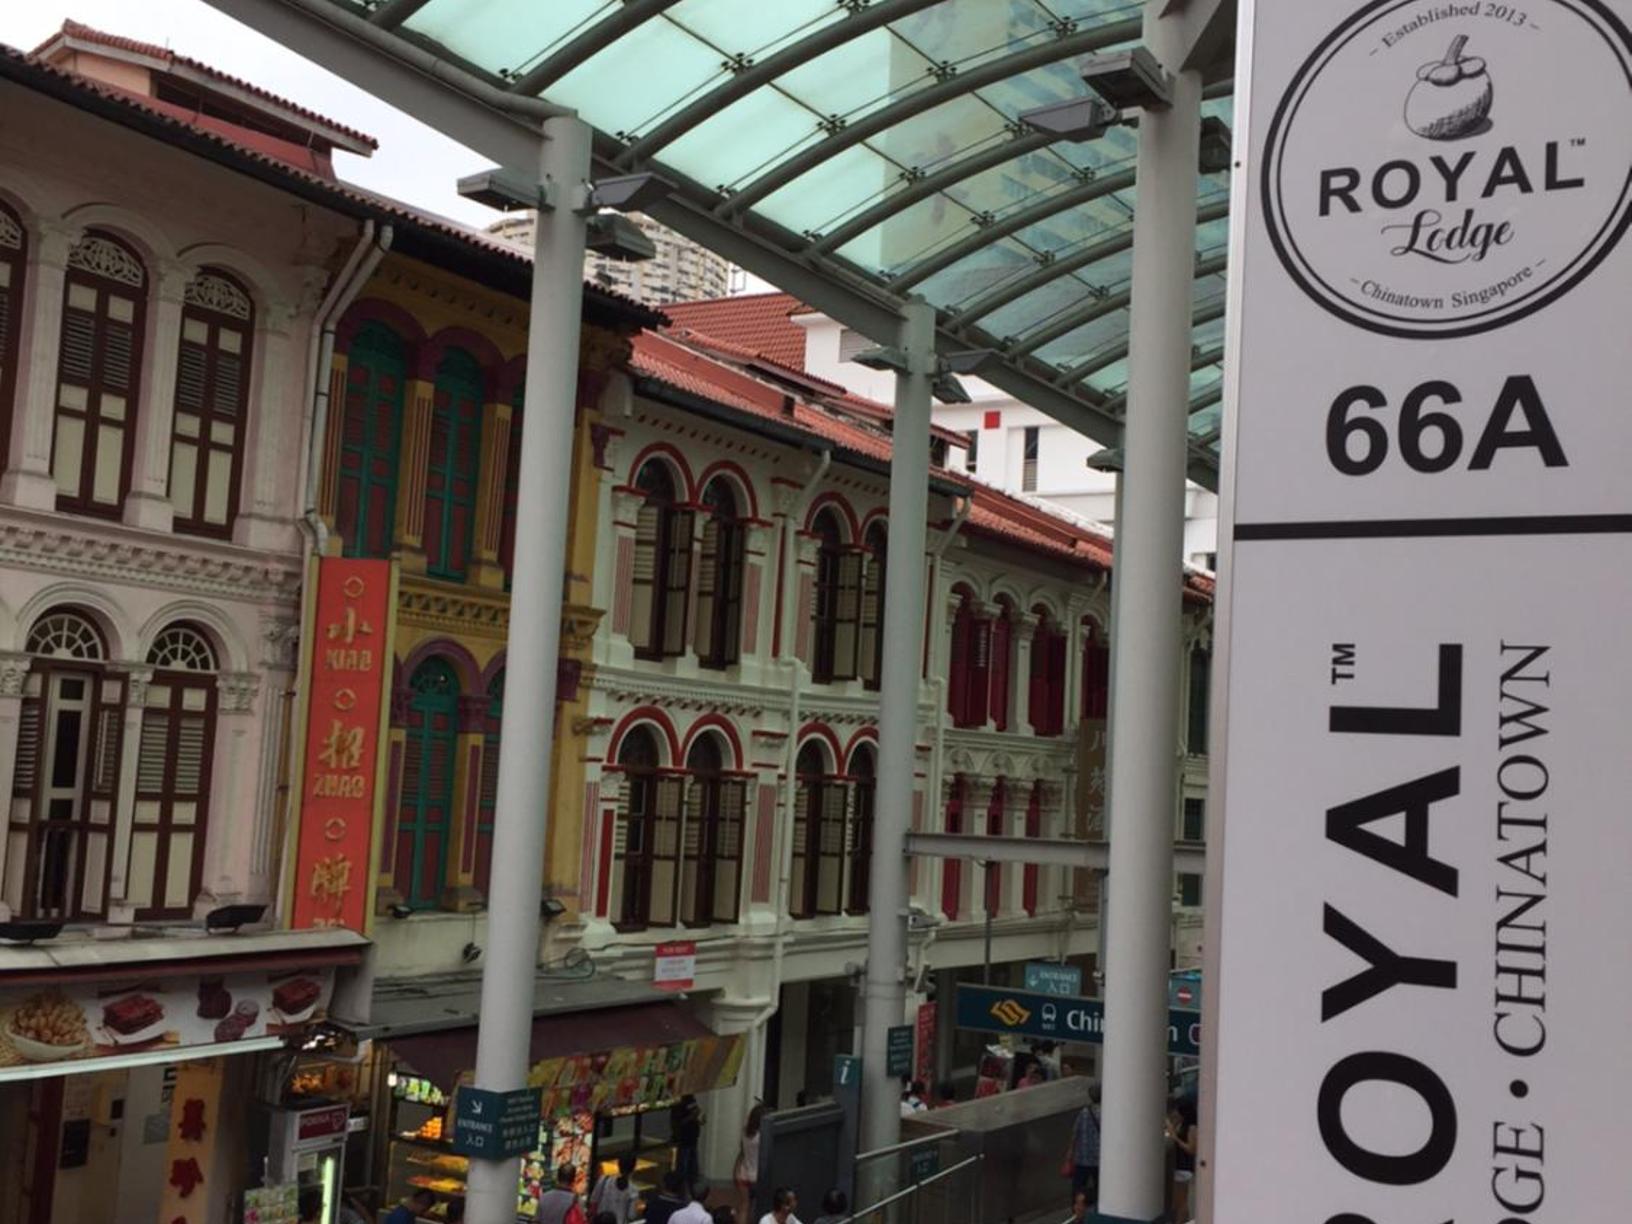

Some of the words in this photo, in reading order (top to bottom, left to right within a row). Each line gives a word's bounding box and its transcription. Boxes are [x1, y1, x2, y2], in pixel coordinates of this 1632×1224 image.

[1381, 1, 1481, 48] Established
[1484, 2, 1528, 27] 2013
[1318, 141, 1585, 217] ROYAL
[1380, 207, 1516, 265] Lodge
[1360, 279, 1444, 310] Chinatown
[1451, 265, 1534, 309] Singapore
[1326, 374, 1570, 477] 66A
[1493, 639, 1551, 1058] CHINATOWN
[1316, 643, 1464, 1224] OYAL
